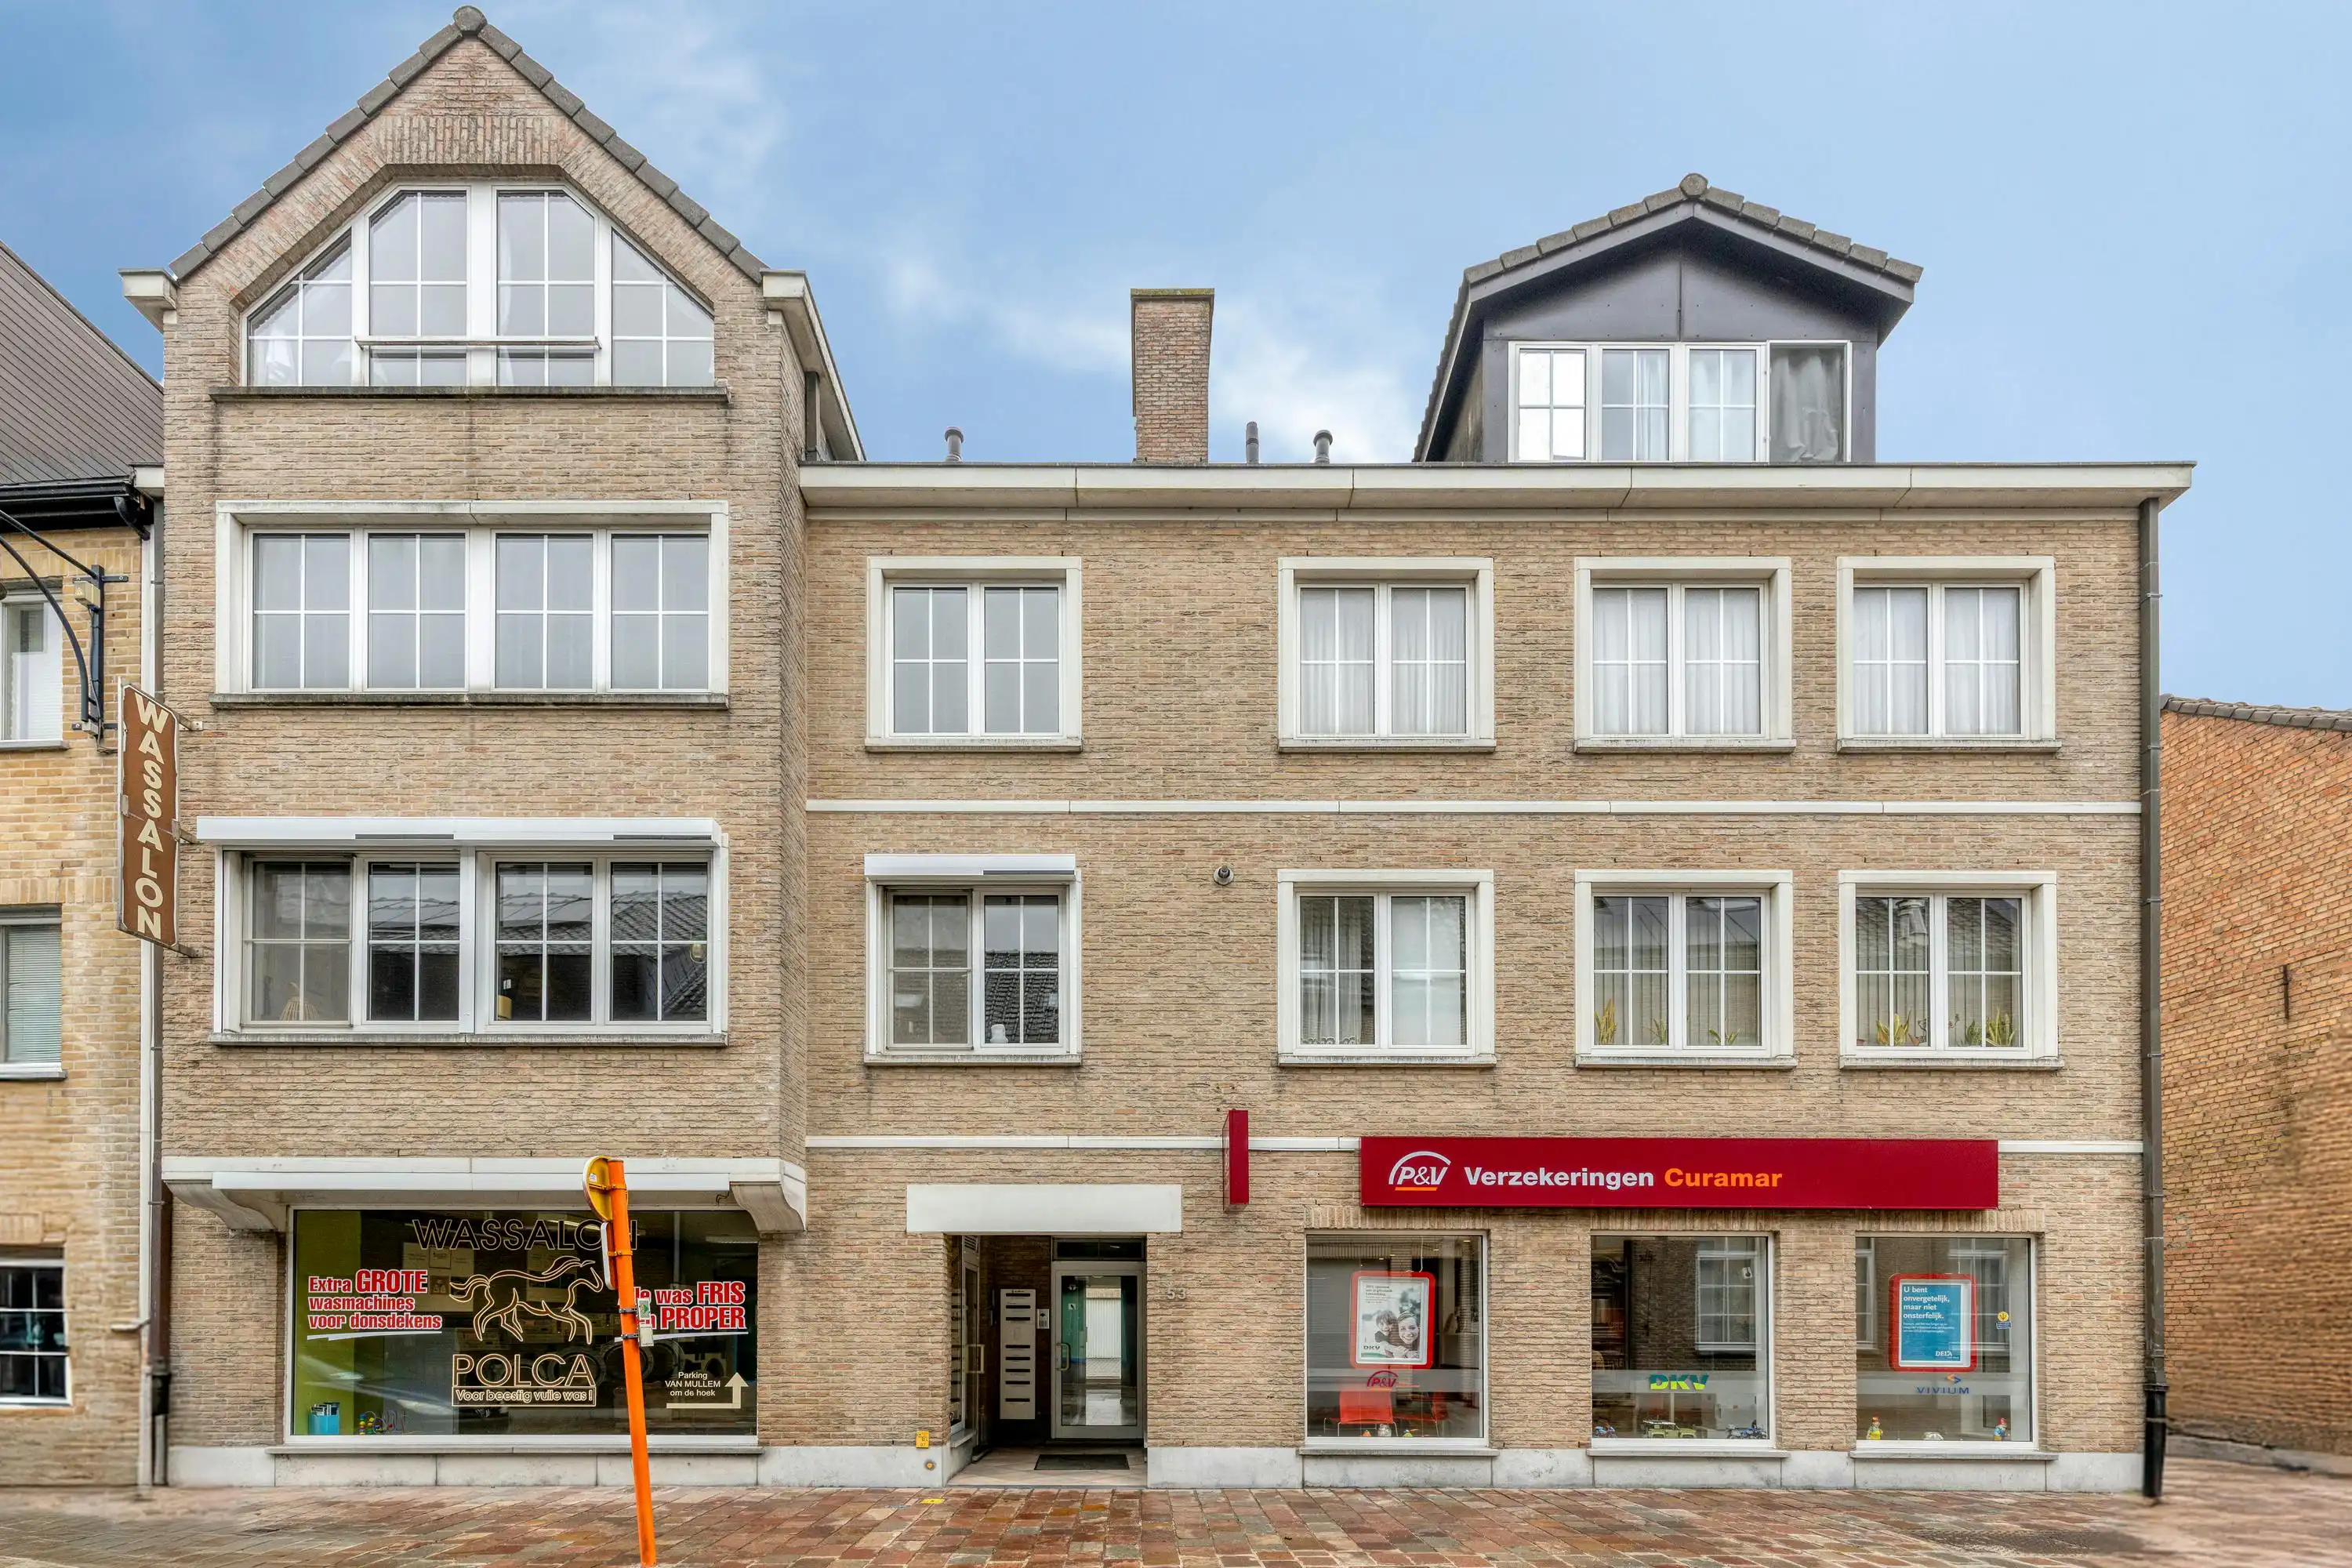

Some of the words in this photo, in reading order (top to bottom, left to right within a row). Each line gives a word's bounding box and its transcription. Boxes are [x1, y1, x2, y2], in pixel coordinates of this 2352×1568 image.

[134, 692, 170, 940] WASSALON
[1396, 1166, 1449, 1185] P&V
[1464, 1167, 1655, 1191] Verzekeringen
[1664, 1167, 1784, 1189] Curamar
[308, 1276, 353, 1294] Extra
[355, 1269, 428, 1294] GROTE
[654, 1289, 693, 1306] was
[696, 1281, 746, 1305] FRIS
[1167, 1287, 1186, 1300] 53
[307, 1294, 416, 1312] wasmachines
[307, 1314, 347, 1330] voor
[349, 1312, 443, 1330] donsdekens
[659, 1306, 747, 1330] PROPER
[452, 1353, 597, 1387] POLCA
[678, 1371, 708, 1380] Parking
[1649, 1374, 1709, 1390] DKV
[1917, 1386, 1969, 1395] VIVIUM
[456, 1389, 485, 1401] Voor
[485, 1389, 532, 1403] beestig
[534, 1389, 562, 1401] vuile
[564, 1391, 587, 1401] was
